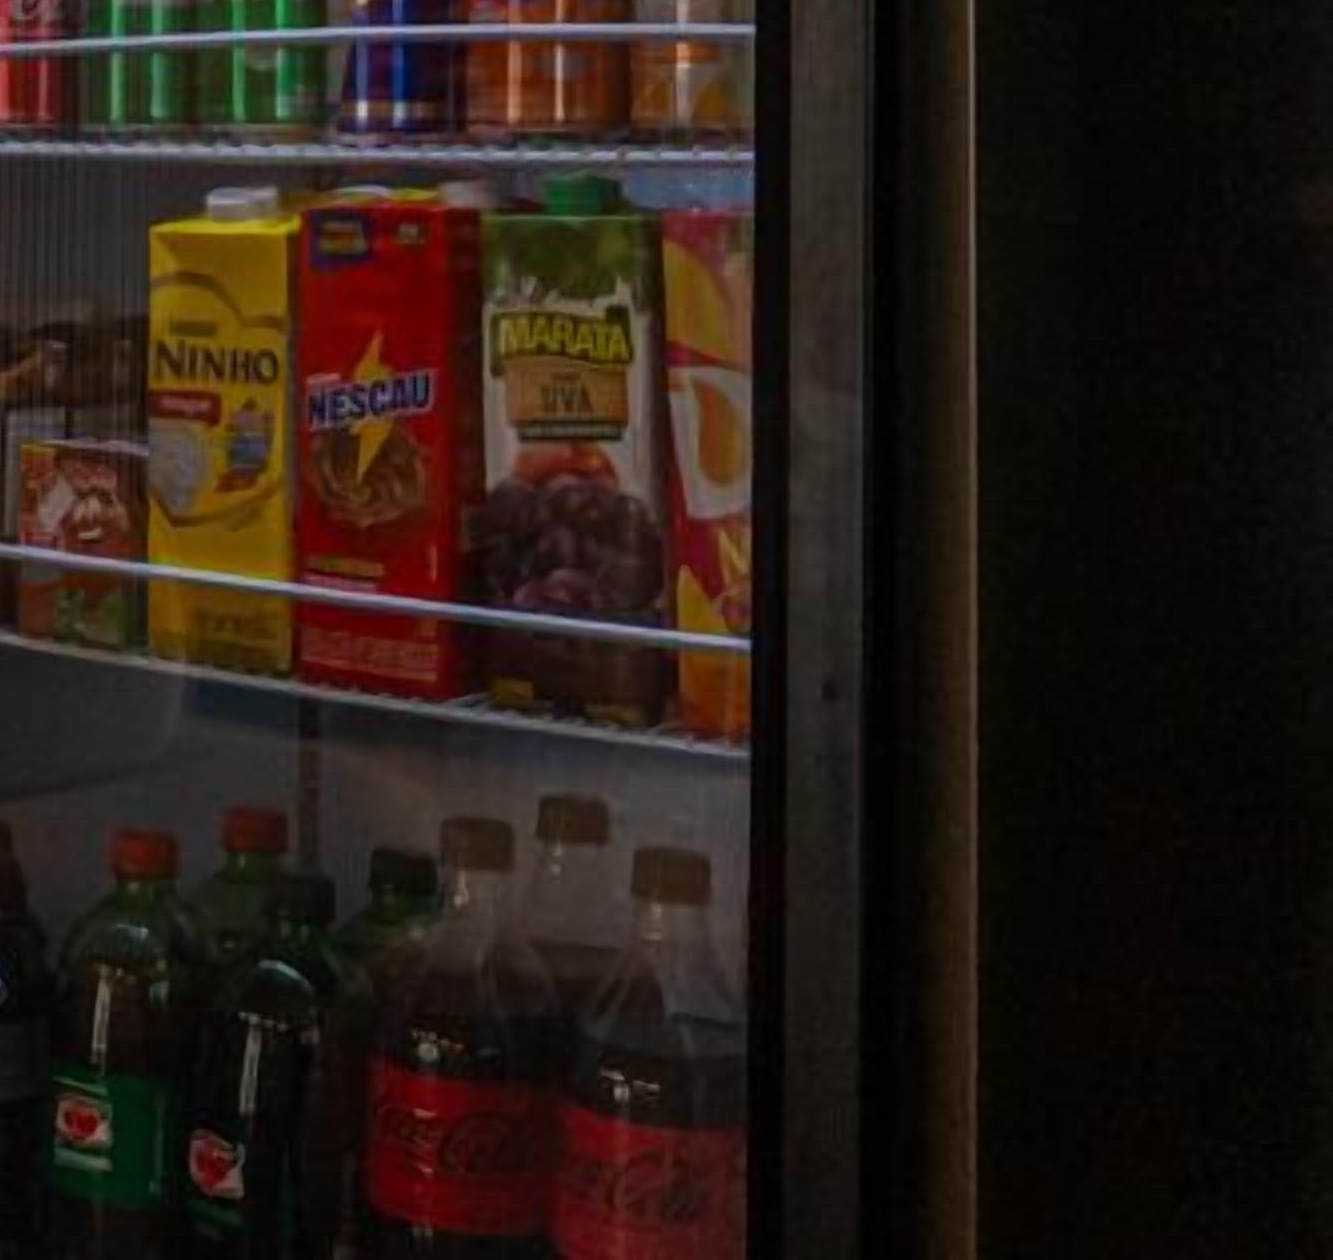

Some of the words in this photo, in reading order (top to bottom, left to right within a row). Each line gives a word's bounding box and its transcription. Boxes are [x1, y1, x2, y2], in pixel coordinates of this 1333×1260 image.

[153, 339, 280, 384] NINHO
[308, 371, 432, 427] NESCAU
[540, 382, 595, 413] UVA
